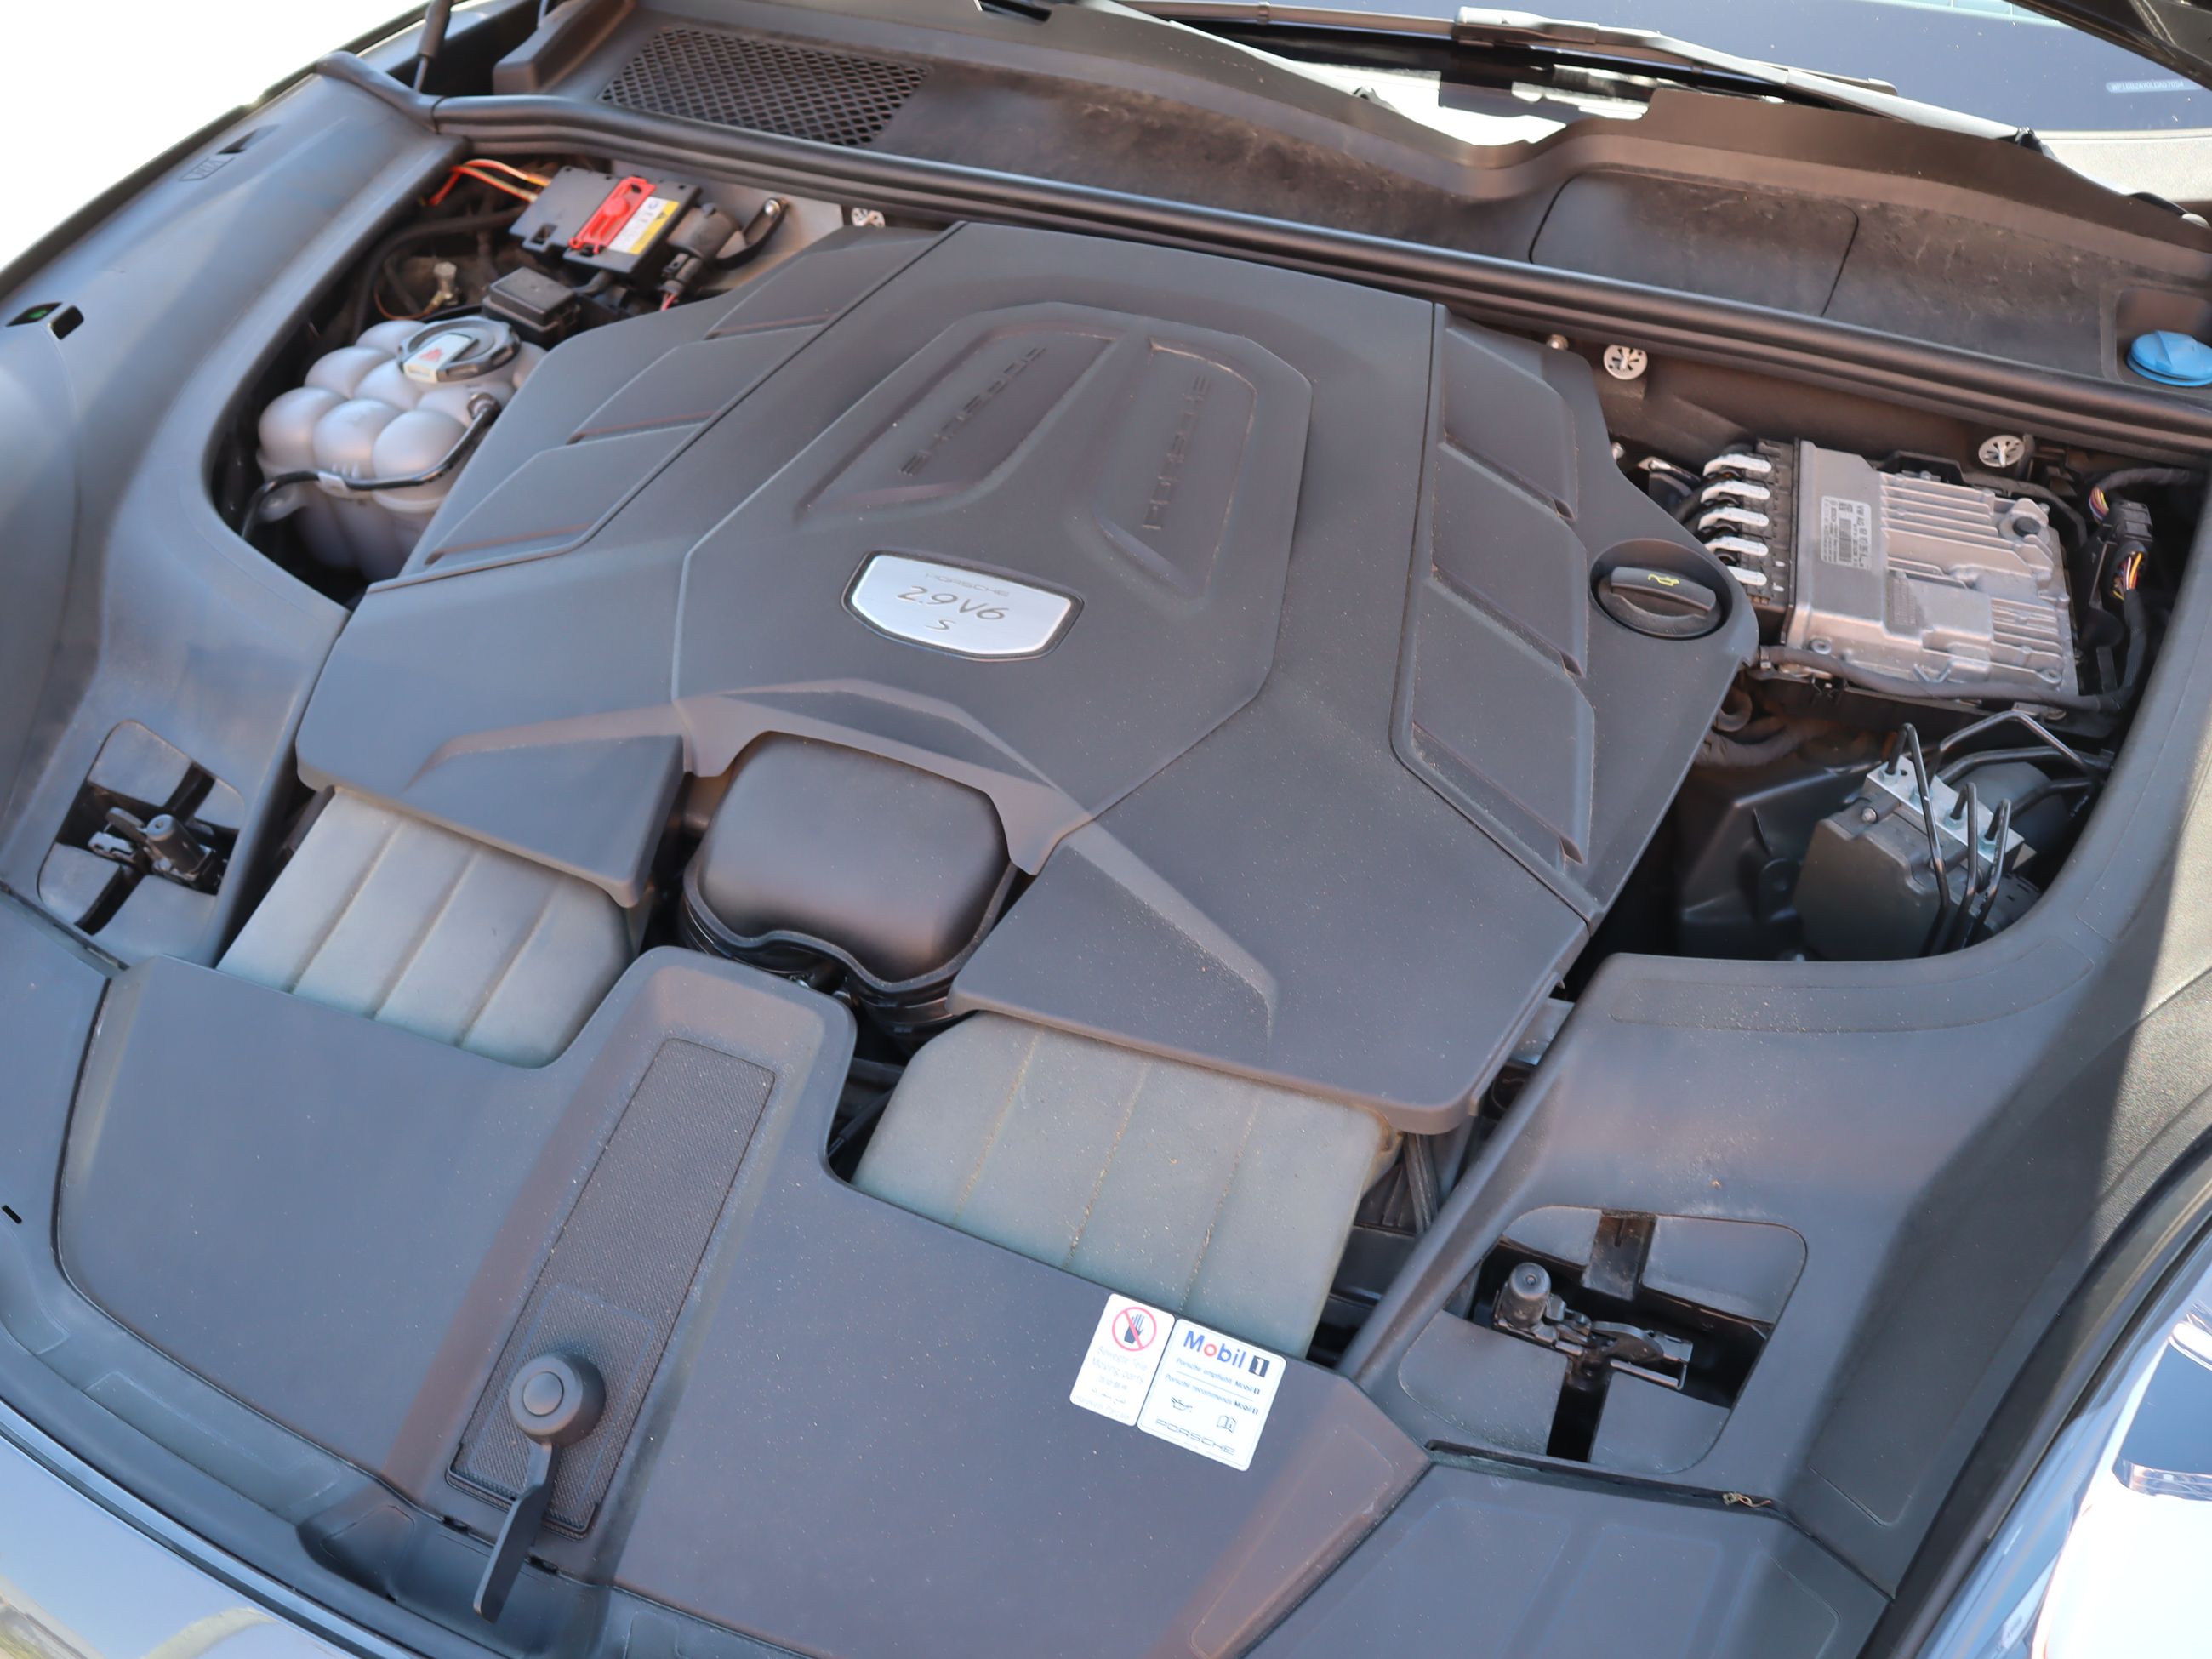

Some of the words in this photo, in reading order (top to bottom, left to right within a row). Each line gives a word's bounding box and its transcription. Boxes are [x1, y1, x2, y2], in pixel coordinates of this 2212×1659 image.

[899, 347, 1047, 476] PORSCHE
[926, 573, 1010, 597] PORSCHE
[925, 619, 956, 631] S
[1175, 1357, 1201, 1372] Porsche
[1183, 1330, 1247, 1369] Mobil
[1248, 1355, 1270, 1378] 1
[1166, 1373, 1190, 1388] Porsche
[1155, 1418, 1236, 1456] PORSCHE
